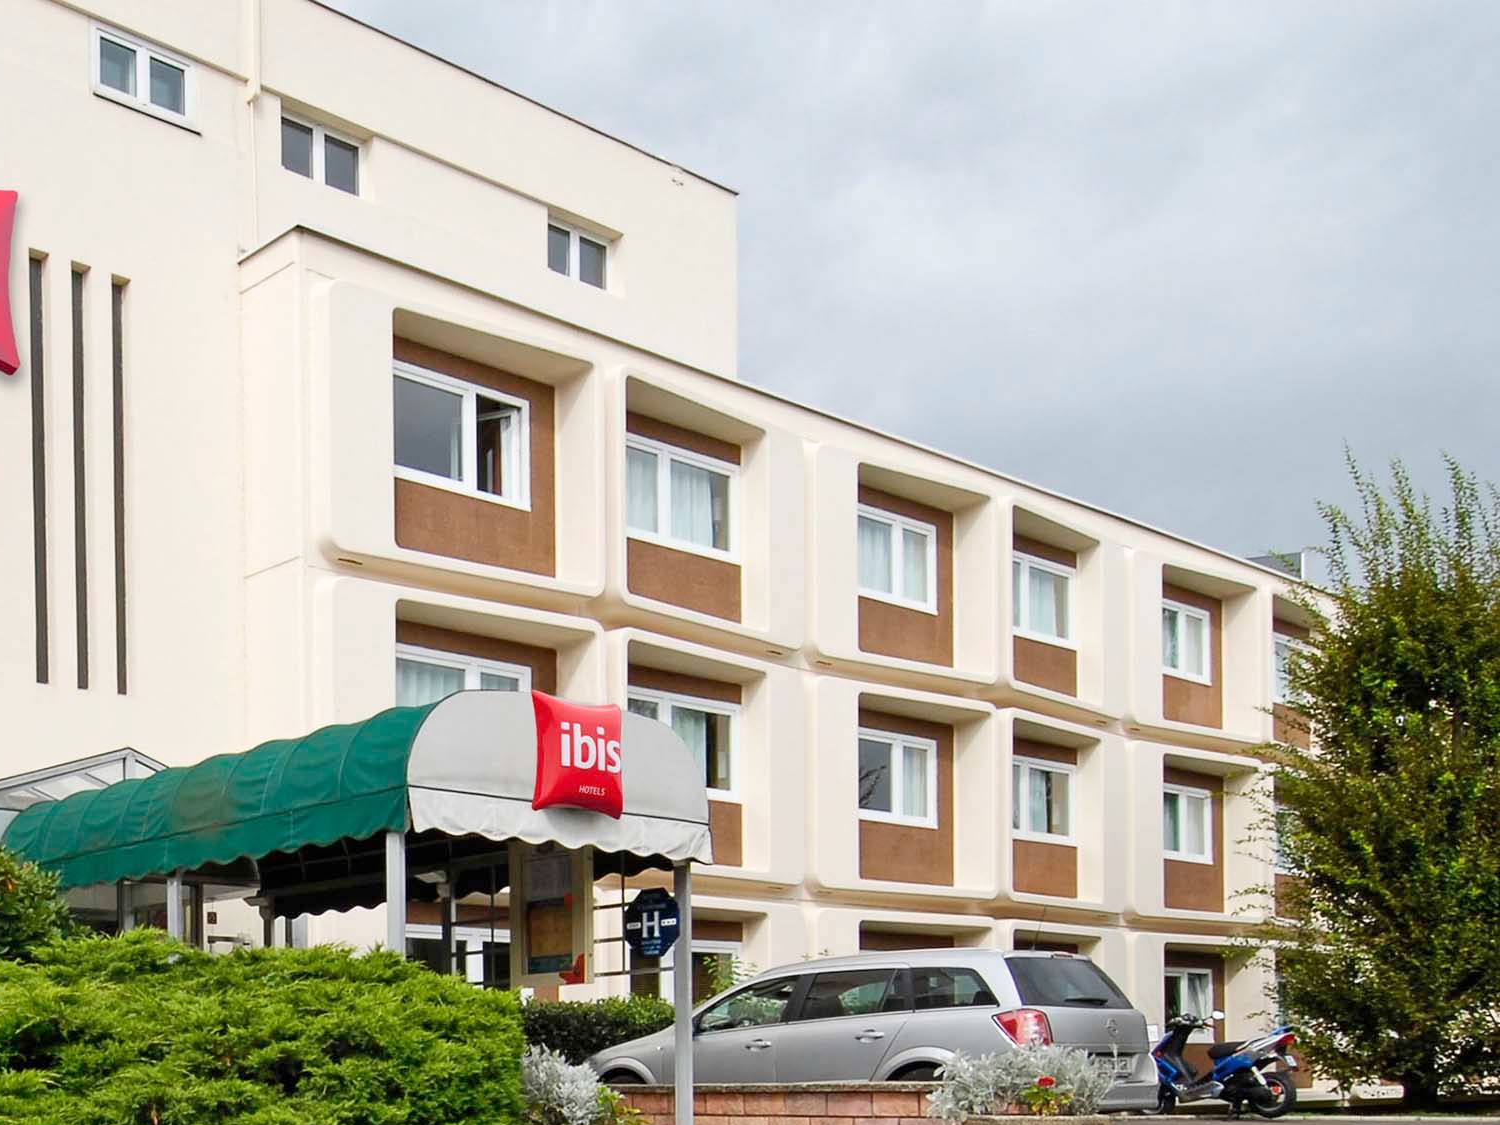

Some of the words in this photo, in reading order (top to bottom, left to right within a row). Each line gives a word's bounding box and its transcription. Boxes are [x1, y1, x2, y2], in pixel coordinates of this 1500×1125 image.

[560, 721, 621, 774] ibis
[578, 785, 606, 796] HOTELS
[642, 911, 660, 938] H
